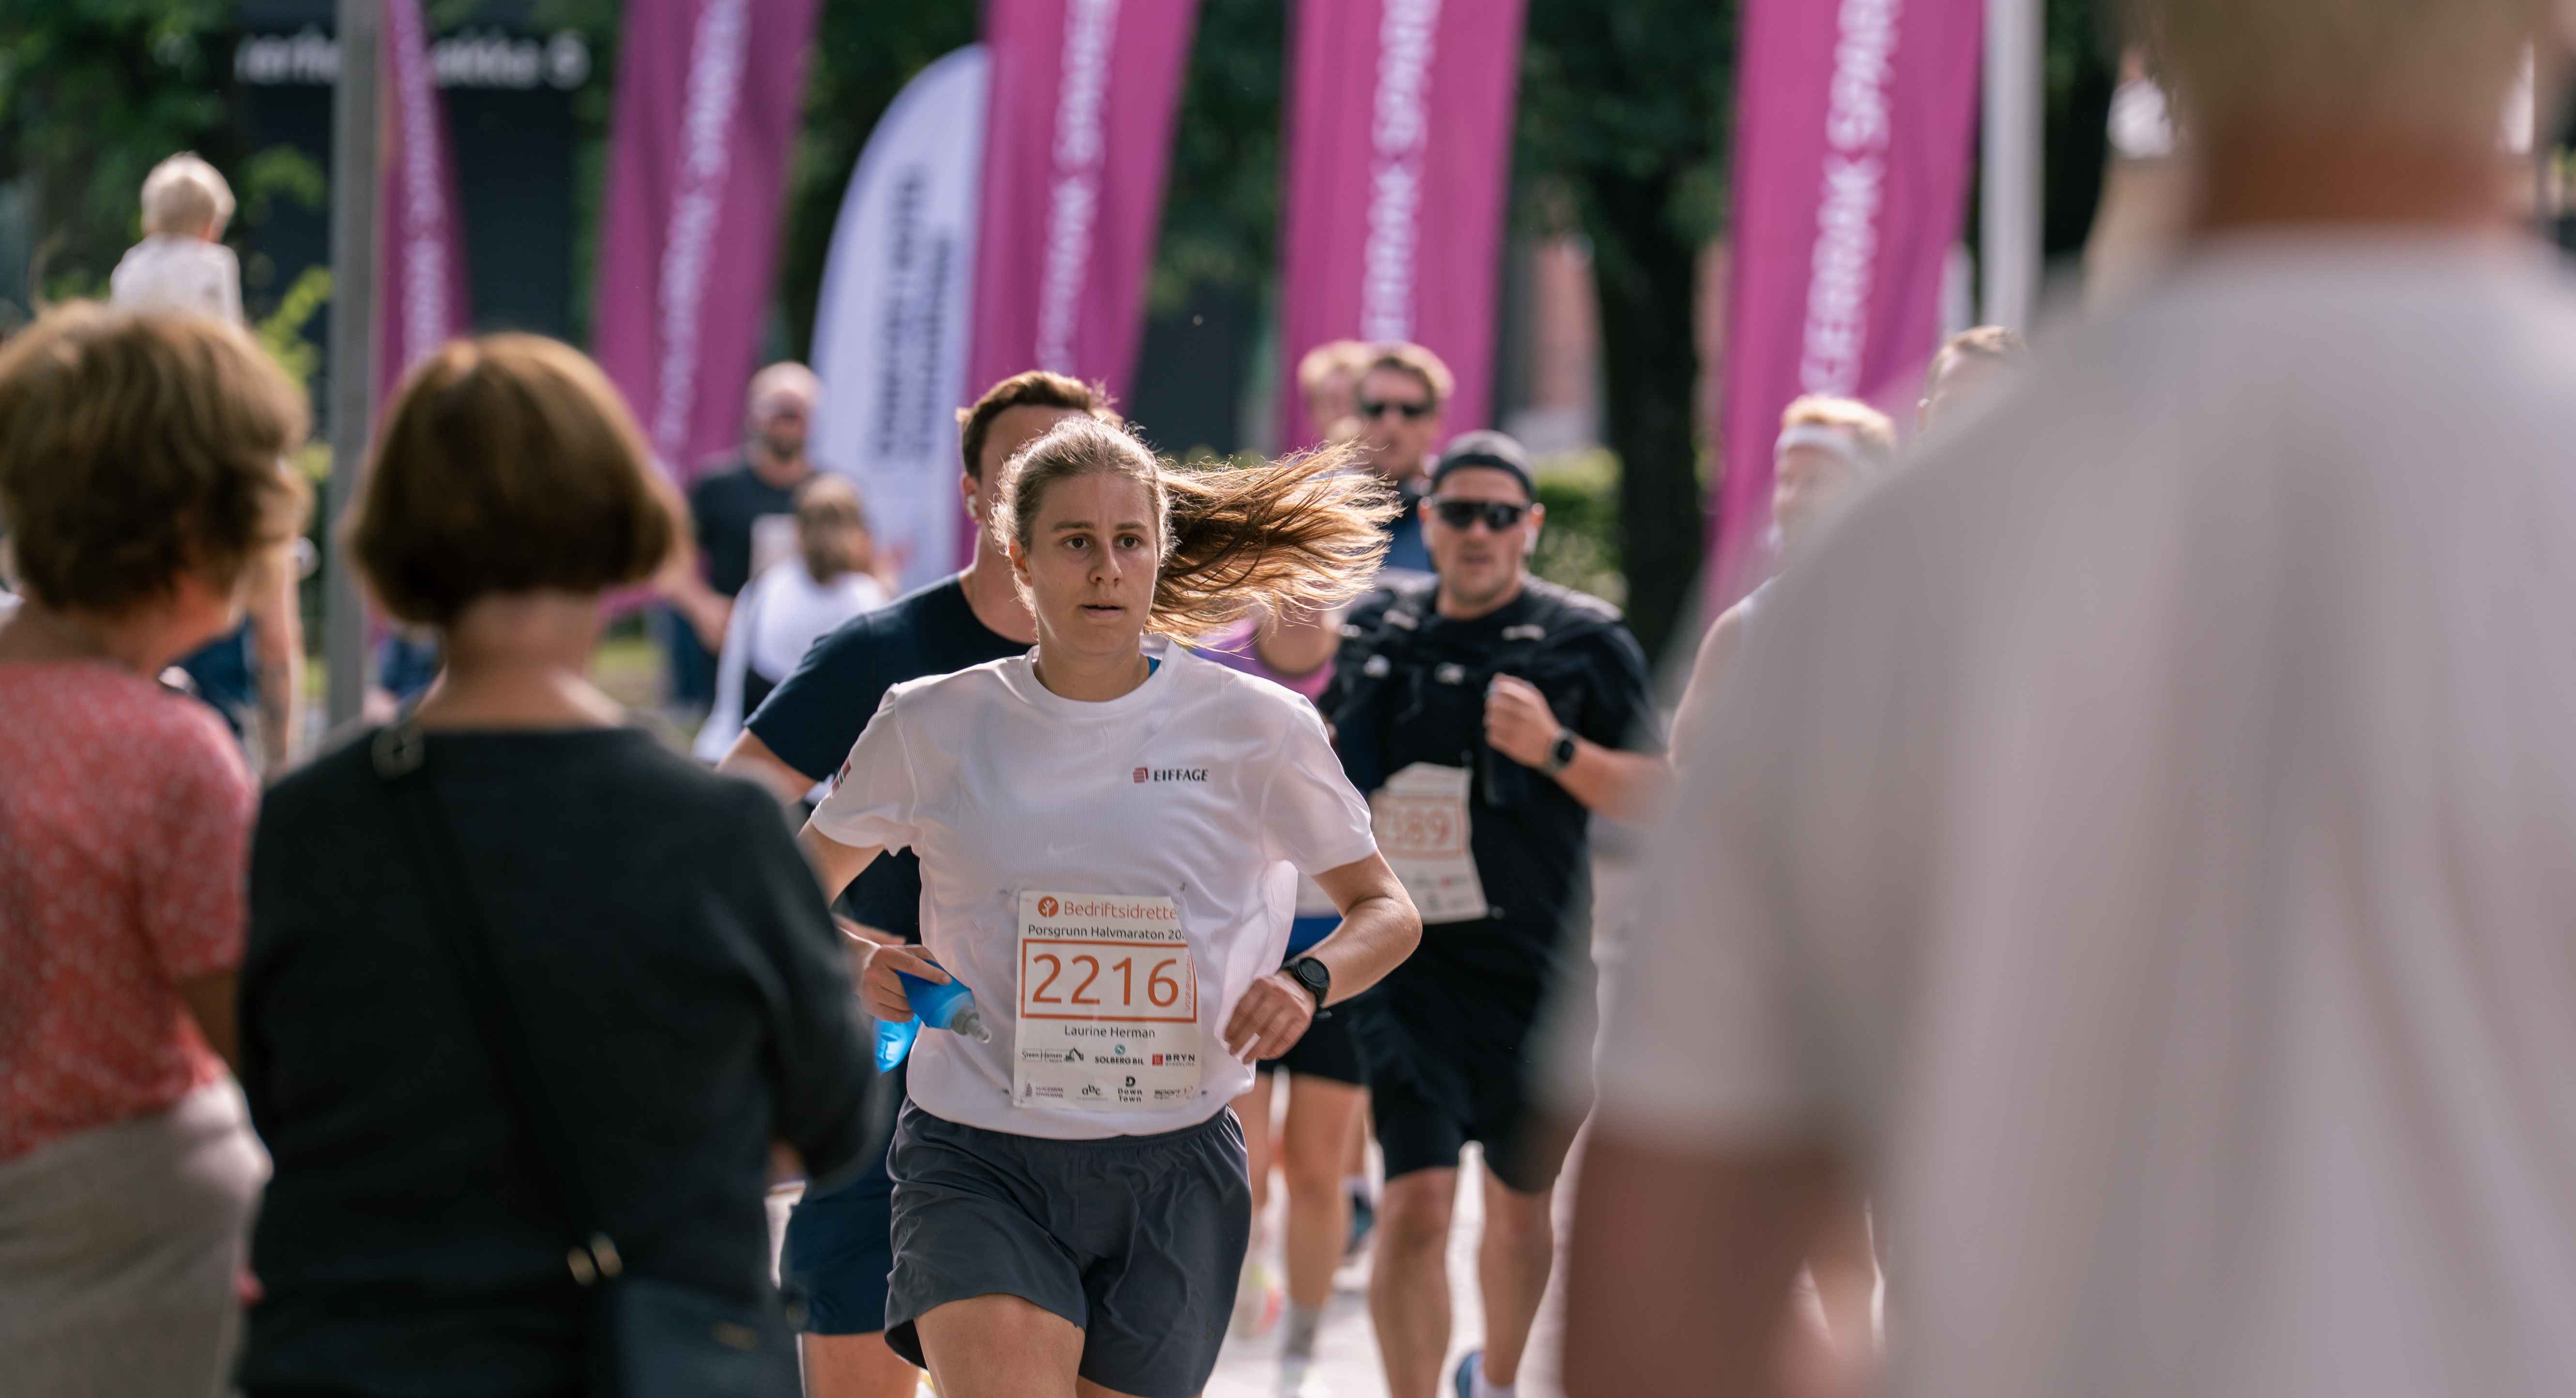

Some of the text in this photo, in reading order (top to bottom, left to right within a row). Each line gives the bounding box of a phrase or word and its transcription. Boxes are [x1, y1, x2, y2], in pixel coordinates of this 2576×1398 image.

[1154, 768, 1209, 782] EIFFAGE
[1065, 901, 1177, 921] Bedriftsidrette
[1028, 924, 1184, 940] Porsgrunn Halvmaraton 20
[1032, 953, 1179, 1008] 2216
[1065, 1025, 1155, 1039] Laurine Herman
[1095, 1056, 1144, 1065] SOLBERG BIL
[1126, 1076, 1136, 1087] D
[1118, 1088, 1142, 1096] Down
